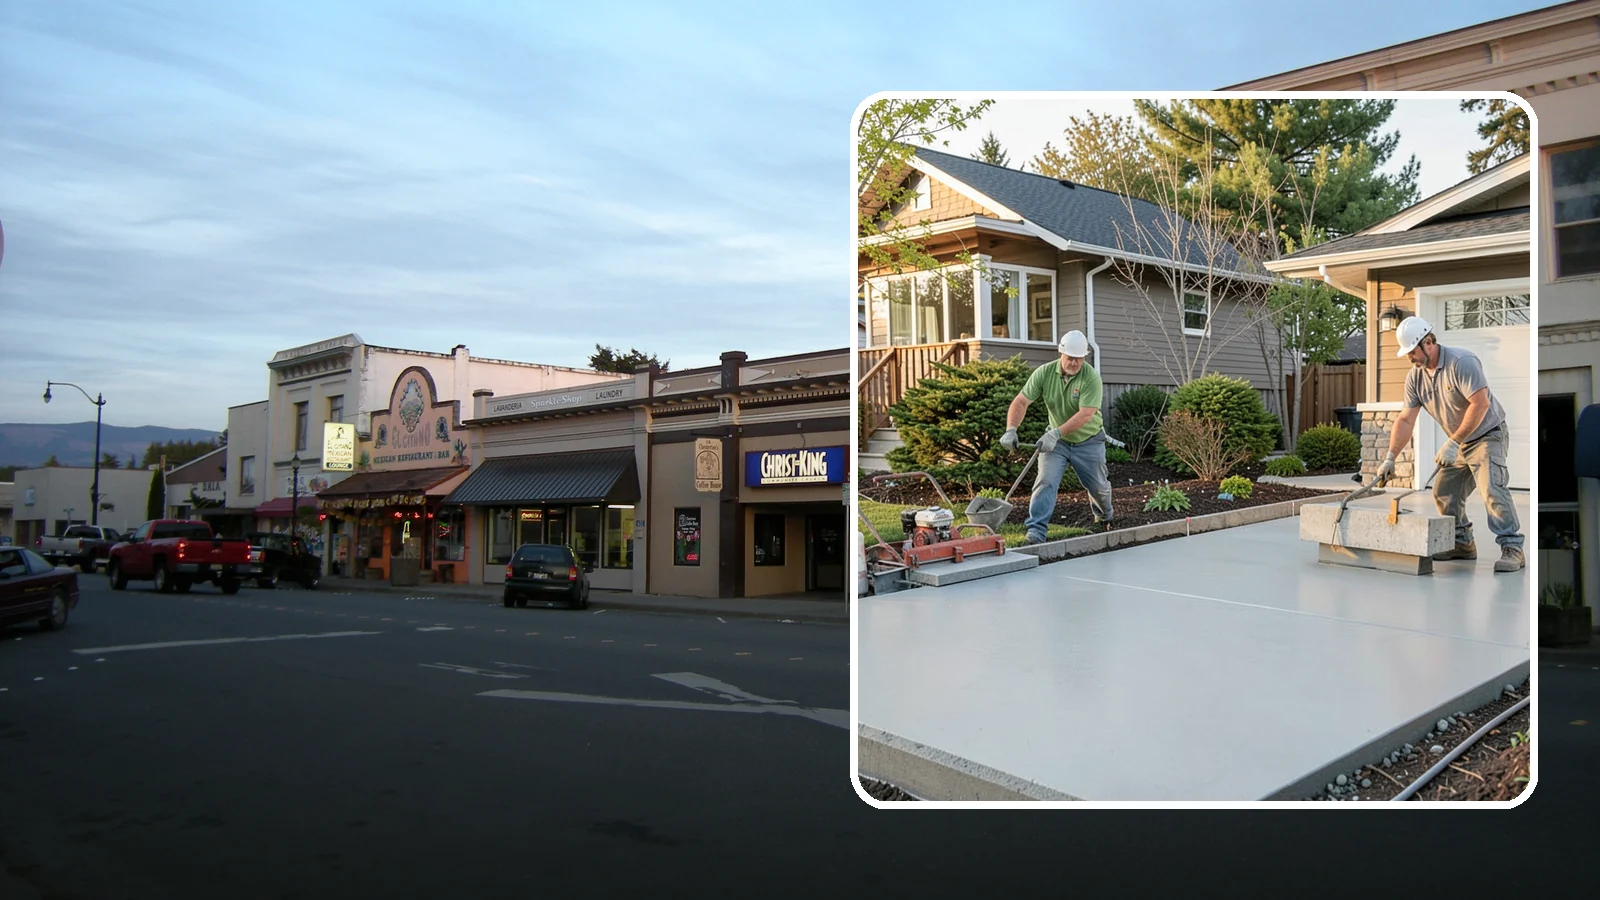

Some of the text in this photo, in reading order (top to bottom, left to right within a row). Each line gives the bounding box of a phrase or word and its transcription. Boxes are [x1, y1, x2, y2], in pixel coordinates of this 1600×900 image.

[493, 389, 623, 413] LAVANDERIA Sparkle Shop LAUNDRY
[374, 450, 450, 463] MEXICAN RESTAURANT BAR
[761, 450, 828, 478] CHRIST KING
